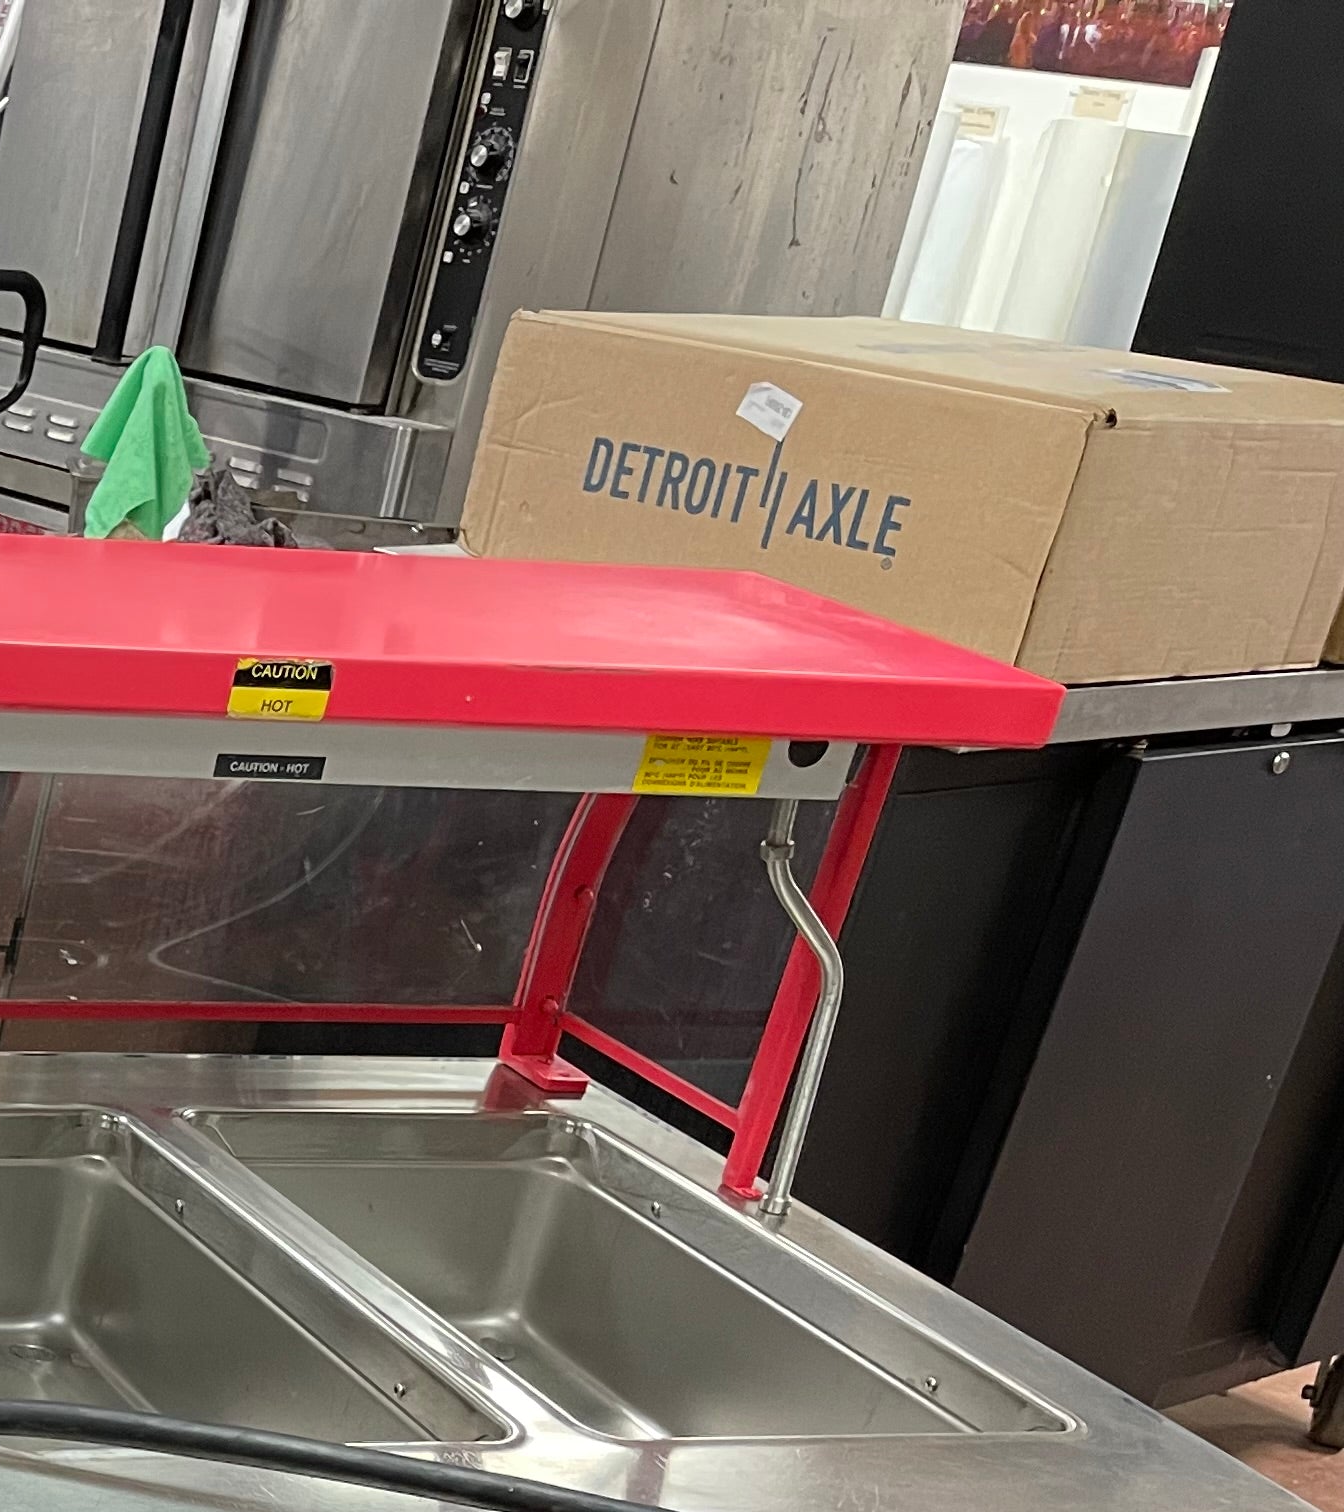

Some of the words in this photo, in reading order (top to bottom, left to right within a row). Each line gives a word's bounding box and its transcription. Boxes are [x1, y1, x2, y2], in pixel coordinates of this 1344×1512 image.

[583, 437, 760, 523] DETROIT
[785, 479, 912, 558] AXLE
[251, 664, 319, 681] CAUTION
[260, 699, 293, 713] HOT
[229, 761, 279, 774] CAUTION
[285, 763, 310, 774] HOT
